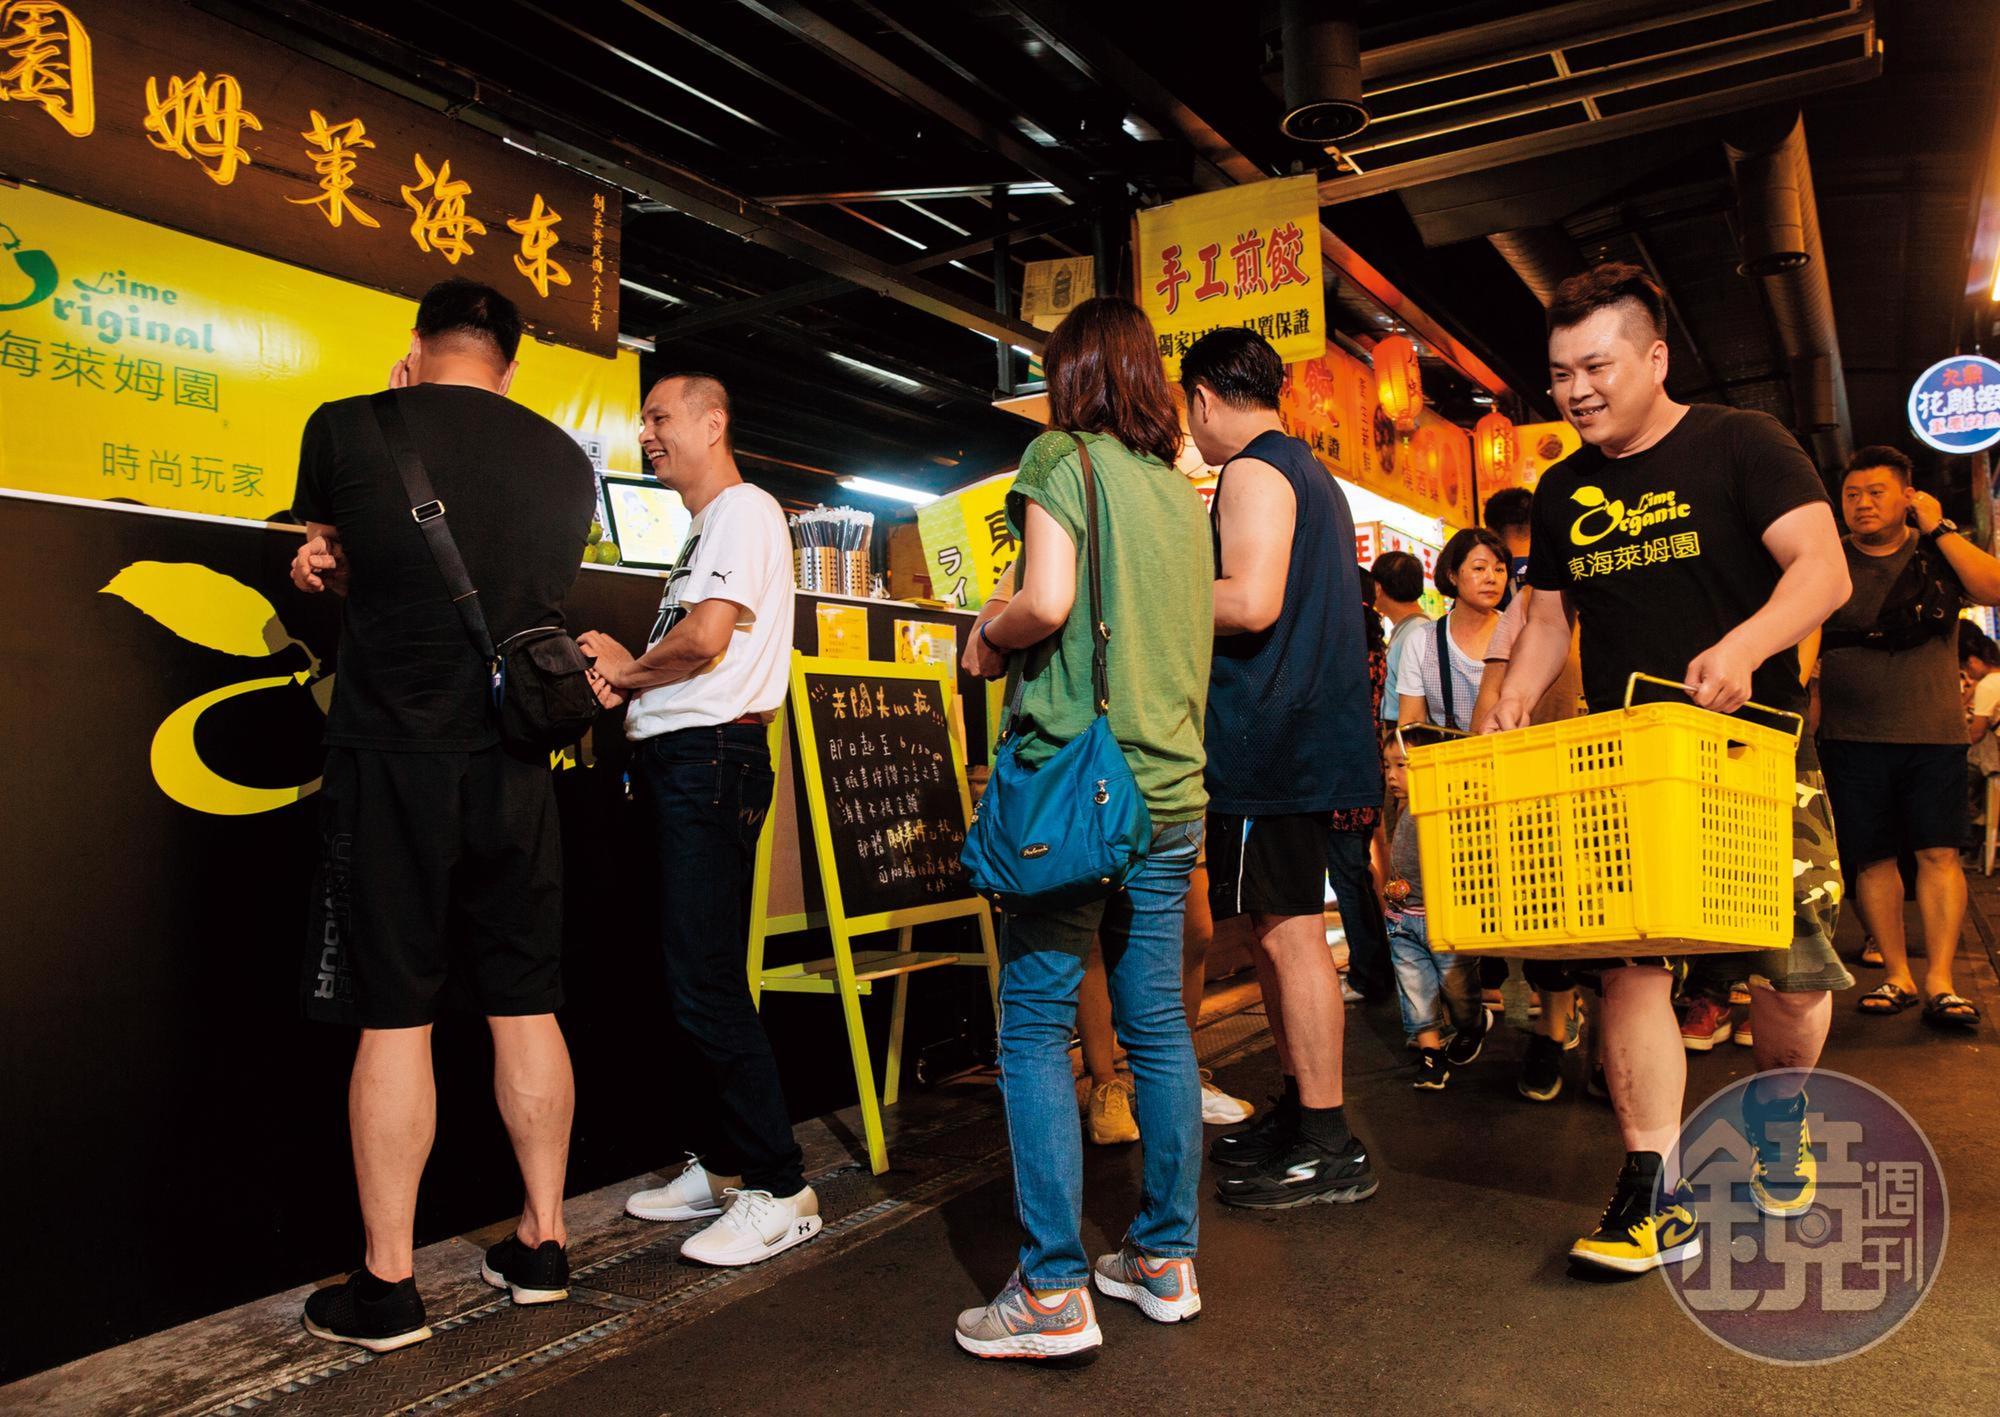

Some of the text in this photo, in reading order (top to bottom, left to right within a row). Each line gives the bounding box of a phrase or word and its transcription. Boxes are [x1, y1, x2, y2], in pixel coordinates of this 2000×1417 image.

[72, 269, 177, 305] Lime
[1155, 221, 1309, 315] 手工煎餃
[102, 442, 264, 497] 時尚玩家
[1626, 490, 1676, 517] Lime
[1567, 531, 1700, 581] 東海萊姆園
